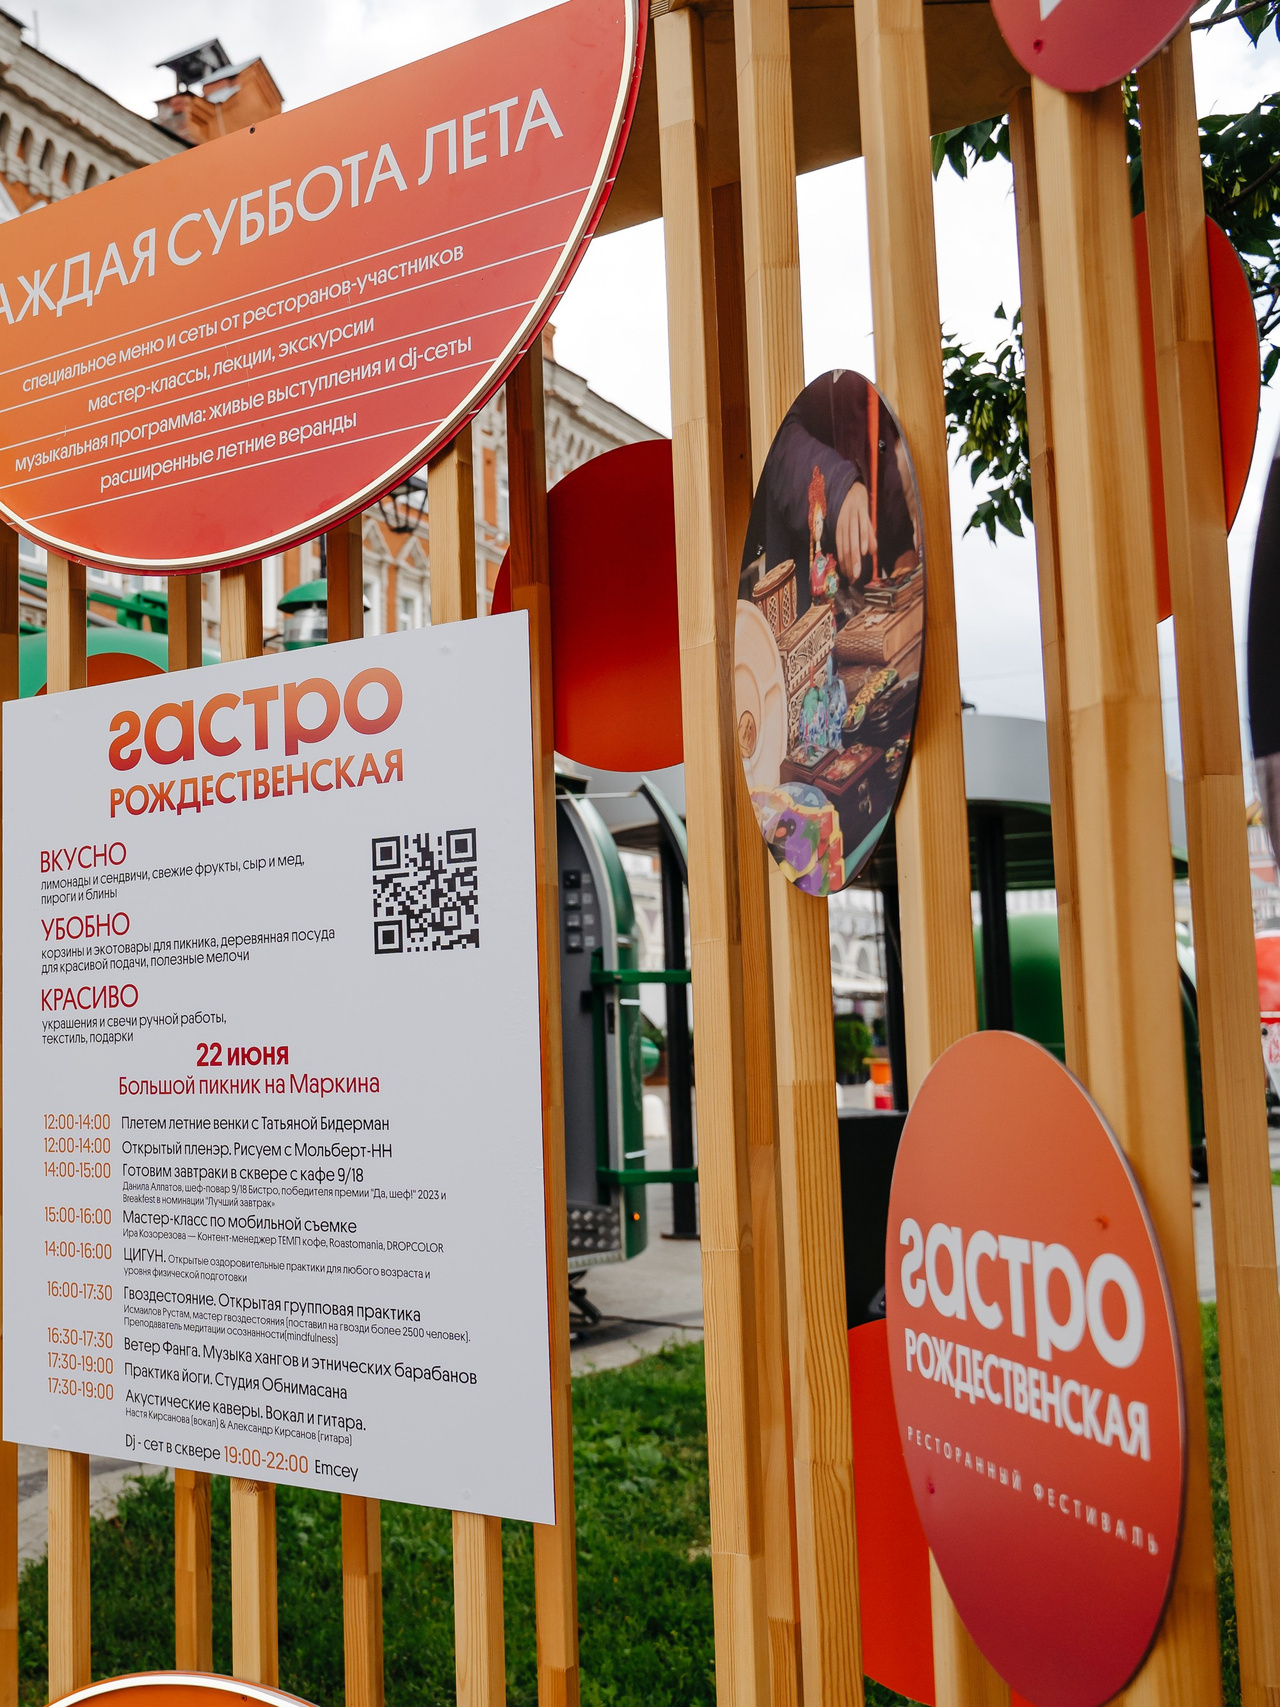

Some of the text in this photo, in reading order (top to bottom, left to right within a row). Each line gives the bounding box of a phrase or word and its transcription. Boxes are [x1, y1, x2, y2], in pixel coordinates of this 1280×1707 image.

[167, 143, 408, 266] СУББОТА
[417, 87, 564, 186] ЛЕТА
[22, 245, 464, 392] специальное меню сеты от ресторанов-участников
[88, 317, 375, 413] мастер-классы, лекции, экскурсии
[15, 335, 472, 472] музыкальная программа: живые выступления dj-сеты
[100, 412, 357, 493] расширенные летние веранды
[110, 748, 404, 819] РОЖДЕСТВЕНСКАЯ
[40, 841, 127, 873] ВКУСНО
[40, 854, 305, 891] лимонады сендвичи, свежие фрукты, сыр мед,
[41, 887, 118, 907] пироги блины
[40, 911, 130, 942] УБОБНО
[41, 928, 335, 961] корзины экотовары для пикника, деревянная посуда
[41, 951, 250, 975] для красивой подачи, полезные мелочи
[41, 983, 139, 1012] КРАСИВО
[41, 1010, 227, 1033] украшения свечи ручной работы,
[41, 1032, 134, 1045] текстиль, подарки
[196, 1042, 289, 1067] 22 июня
[119, 1073, 380, 1099] Большой пикник Маркина
[43, 1113, 390, 1134] 12:00-14:00 Плетем летние венки Татьяной Бидерман
[44, 1137, 393, 1161] 12:00-14:00 Открытый пленэр. Рисуем Мольберт-НН
[43, 1161, 111, 1179] 14:00-15:00
[122, 1163, 172, 1178] Готовим
[174, 1166, 229, 1182] завтраки
[239, 1168, 288, 1183] сквере
[300, 1166, 335, 1185] кафе
[184, 1183, 440, 1200] шеф-повар Бистро, победителя премии 2023
[44, 1206, 357, 1234] 15:00-16:00 Мастер-класс по мобильной съемке
[122, 1228, 139, 1239] Ира
[197, 1231, 277, 1247] Контент-менеджер
[302, 1236, 328, 1249] кофе,
[329, 1237, 386, 1251] Roastomania,
[386, 1240, 444, 1253] DROPCOLOR
[44, 1240, 424, 1279] 14:00-16:00 ЦИГУН. Открытые оздоровительные практики для любого возраста
[151, 1267, 247, 1283] физической подготовки
[47, 1280, 421, 1323] 16:00-17:30 Гвоздестояние. Открытая групповая практика
[123, 1304, 425, 1338] Исмаилов мастер гвоздестояния гвозди более 2500
[123, 1316, 226, 1335] Преподаватель медитации
[47, 1327, 478, 1385] 16:30-17:30 Ветер Фанга. Музыка хангов этнических барабанов
[47, 1351, 348, 1400] 17:30-19:00 Практика йоги. Студия Обнимасана
[47, 1377, 367, 1433] 17:30-19:00 Акустические каверы. Вокал гитара.
[904, 1327, 1151, 1462] РОЖДЕСТВЕНСКАЯ
[148, 1410, 317, 1440] Кирсанова Александр Кирсанов
[125, 1433, 359, 1483] Dj сет сквере 19:00-22:00 Emcey
[907, 1425, 1159, 1555] РЕСТОРАННЫЙ ФЕСТИВАЛЬ
